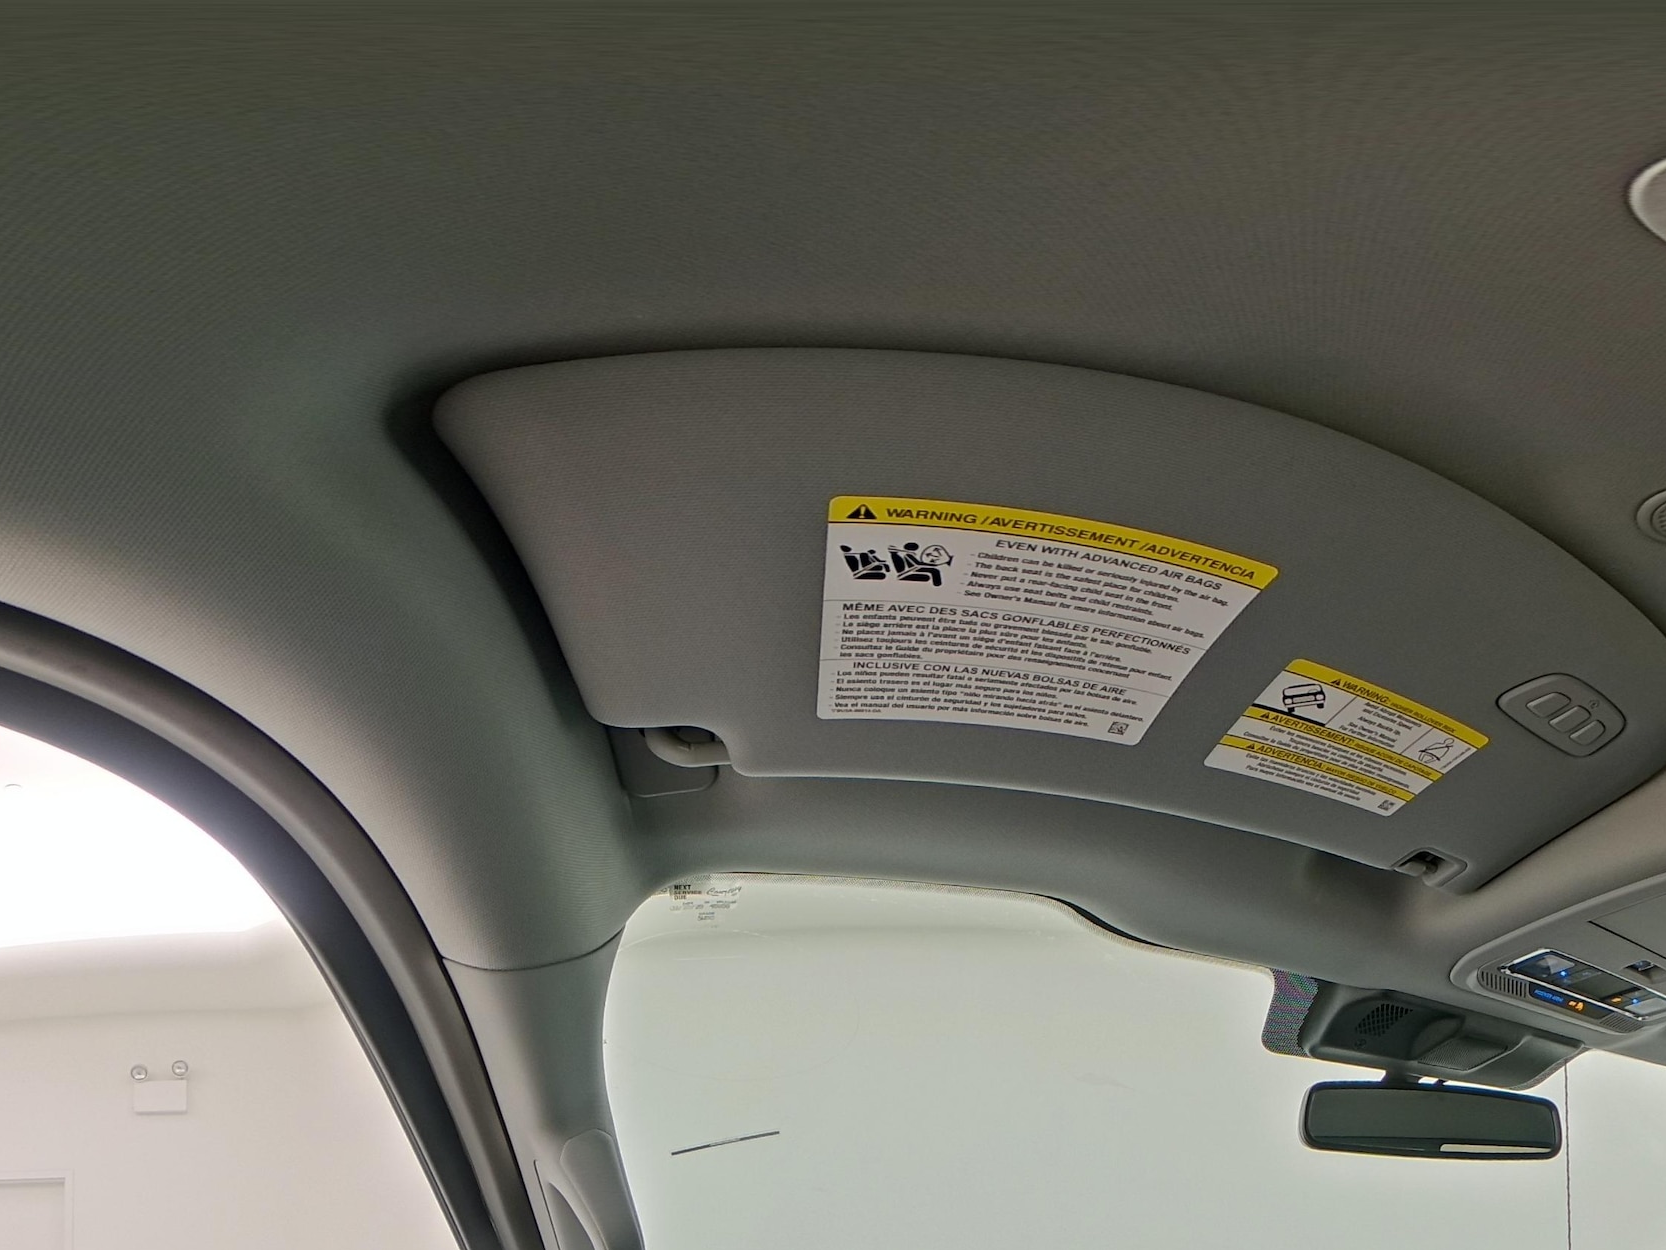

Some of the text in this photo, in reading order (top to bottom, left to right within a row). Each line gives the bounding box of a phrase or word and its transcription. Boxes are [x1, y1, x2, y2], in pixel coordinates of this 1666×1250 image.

[886, 508, 976, 524] WARNING
[975, 562, 993, 570] The
[996, 564, 1019, 573] back
[1022, 567, 1043, 575] seat
[1056, 572, 1071, 580] the
[1073, 576, 1102, 586] safest
[1103, 580, 1127, 591] place
[1129, 585, 1142, 593] for
[1143, 588, 1179, 602] children.
[978, 552, 1020, 563] Children
[1043, 560, 1054, 568] be
[1057, 561, 1083, 572] killed
[1097, 570, 1137, 583] seriously
[1139, 578, 1171, 590] injured
[1171, 586, 1182, 594] by
[1184, 588, 1198, 597] the
[1198, 593, 1211, 601] air
[1211, 597, 1228, 607] bag.
[995, 539, 1223, 590] EVEN WITH ADVANCED AIR BAGS
[967, 581, 1001, 590] Always
[1023, 587, 1043, 595] seat
[1045, 589, 1067, 599] belts
[1069, 594, 1087, 602] and
[1088, 597, 1110, 606] child
[1112, 601, 1154, 616] restraints.
[970, 571, 998, 580] Never
[1028, 578, 1078, 591] rear-facing
[1080, 585, 1104, 595] child
[1105, 591, 1123, 599] seat
[1125, 594, 1134, 602] in
[1135, 596, 1150, 605] the
[1151, 599, 1173, 611] front.
[842, 602, 1191, 655] MÊME AVEC DES SACS GONFLABLES PERFECTIONNÉS
[984, 592, 1021, 601] Owner's
[1023, 597, 1057, 607] Manual
[1073, 605, 1096, 613] more
[1098, 608, 1146, 623] information
[1147, 619, 1171, 629] about
[1185, 628, 1205, 638] bags.
[853, 661, 1127, 696] INCLUSIVE CON LAS NUEVAS BOLSAS DE AIRE
[1343, 680, 1390, 704] WARNING:
